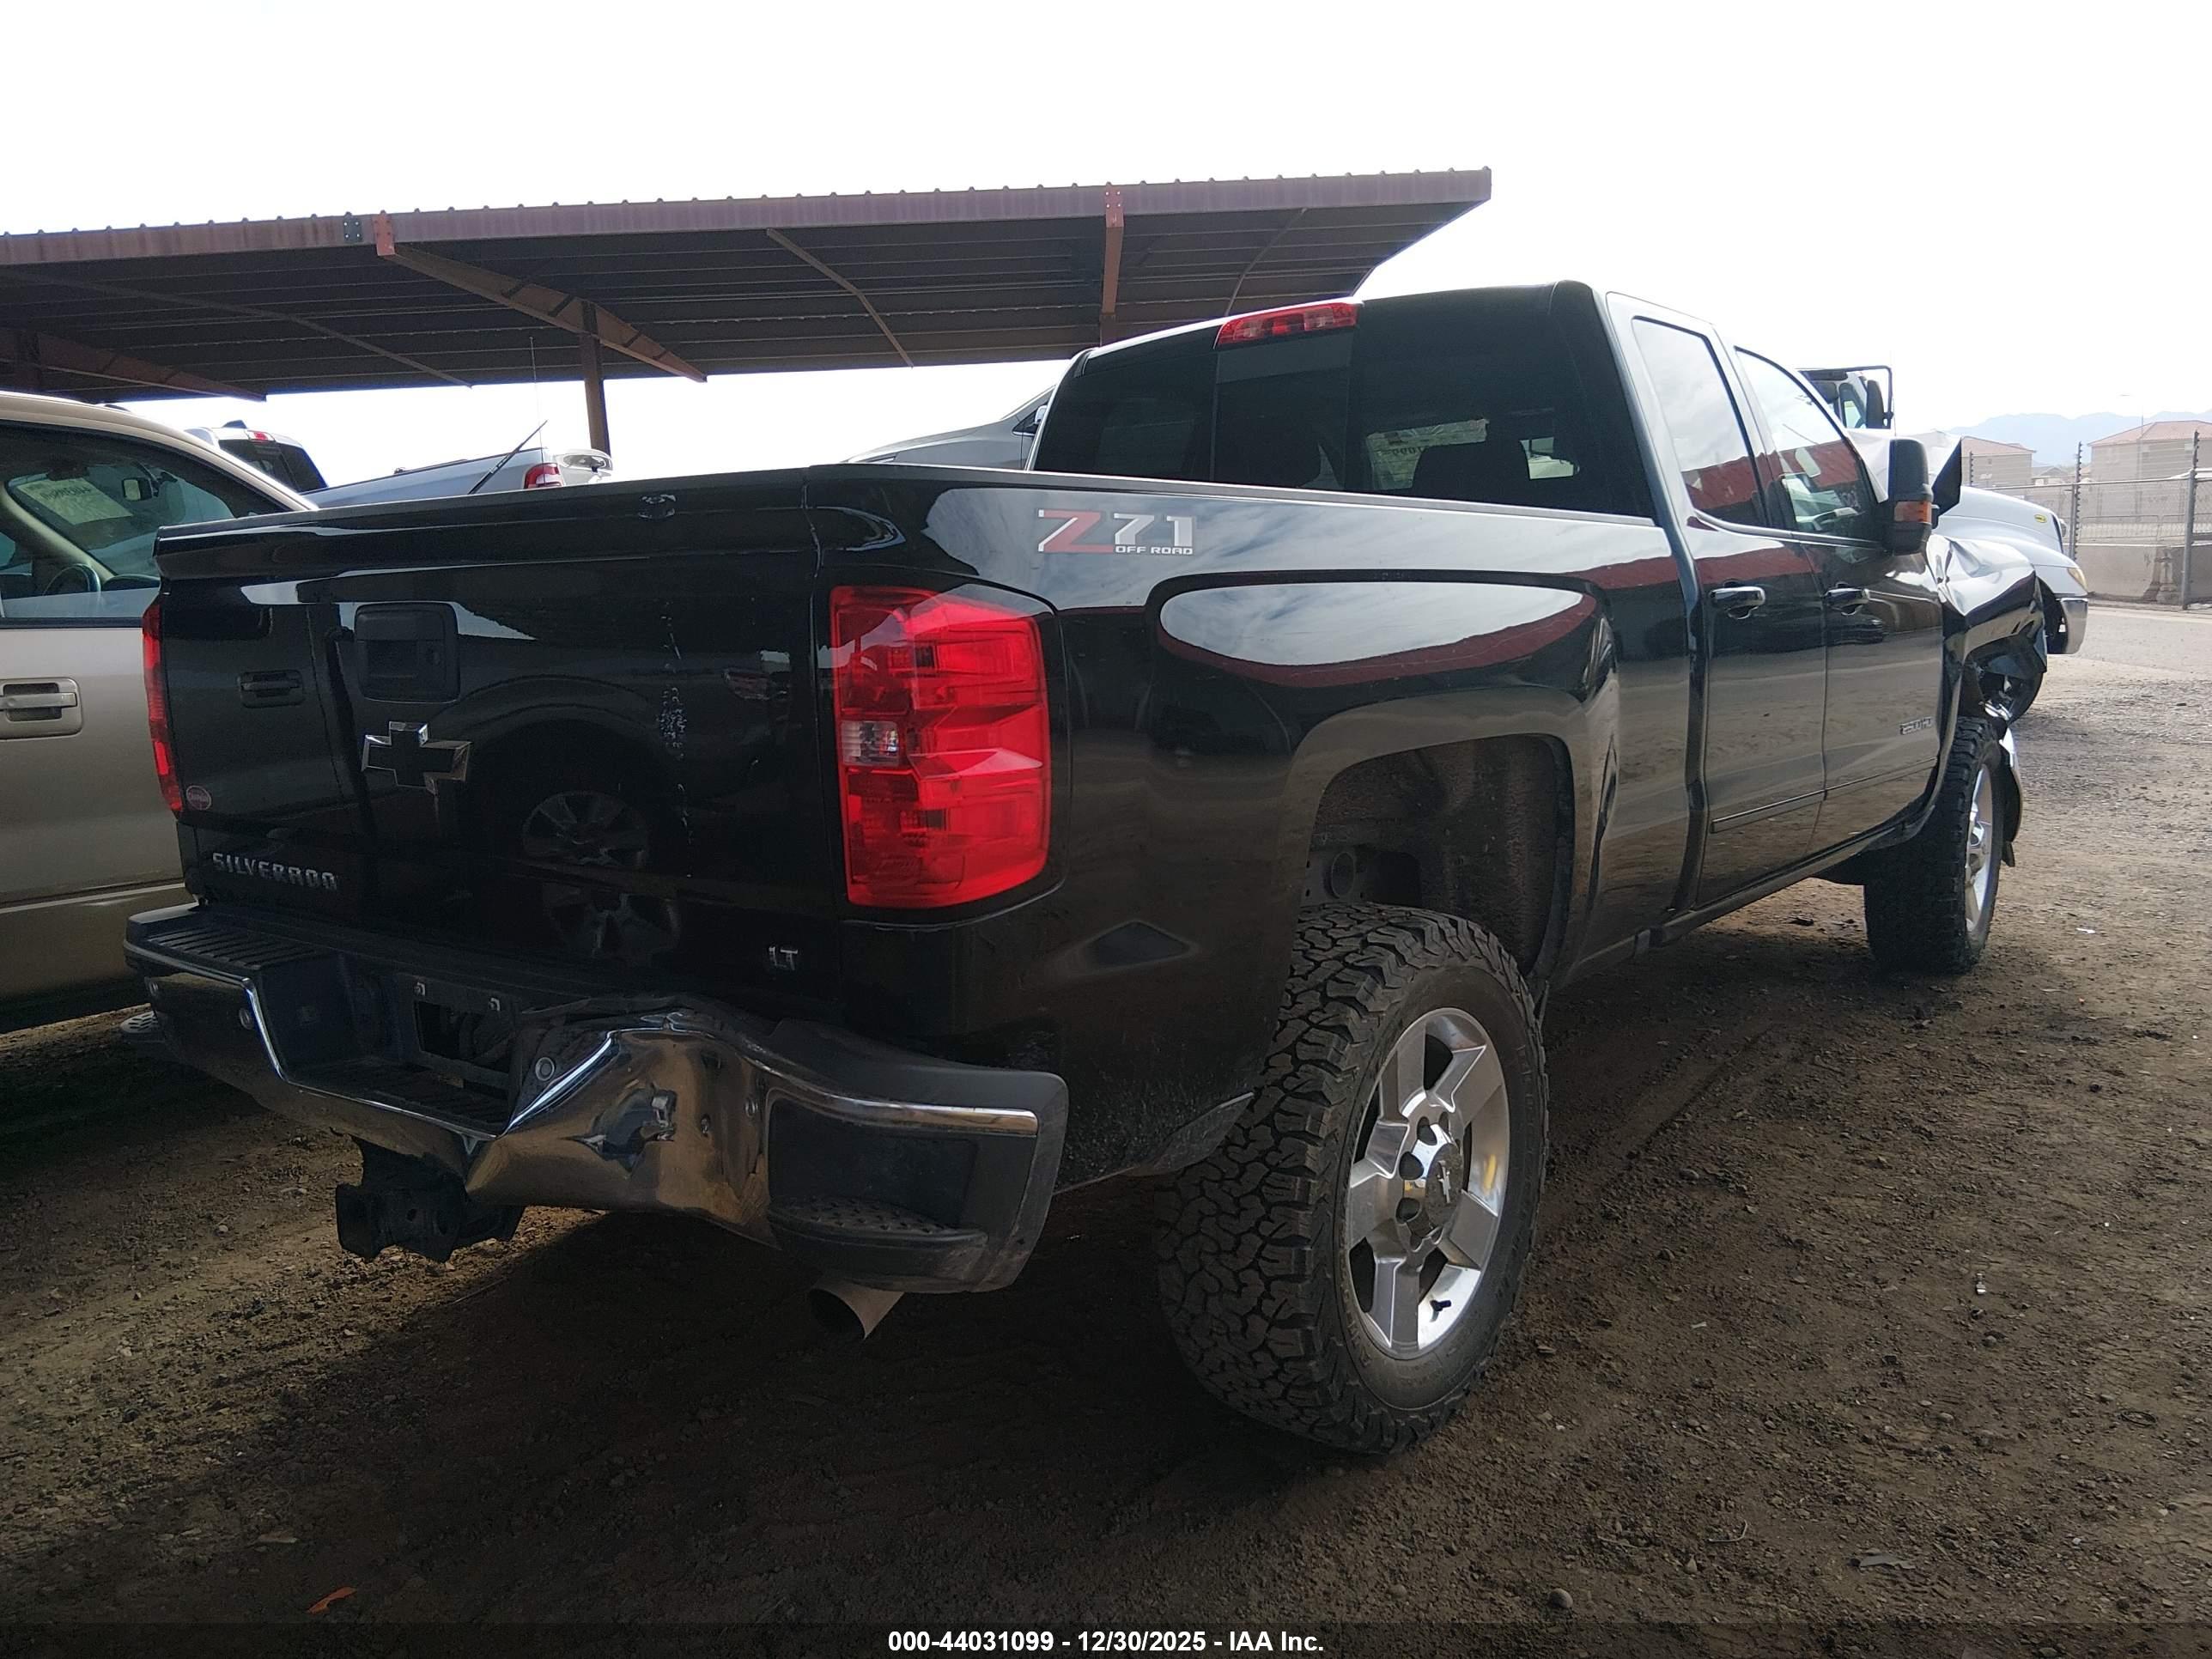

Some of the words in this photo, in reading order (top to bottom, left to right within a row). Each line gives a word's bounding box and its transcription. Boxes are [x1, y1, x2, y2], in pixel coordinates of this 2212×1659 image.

[1038, 509, 1194, 553] Z71
[1115, 545, 1146, 554] OFF
[1151, 546, 1194, 556] ROAD
[212, 853, 338, 890] SILVERADO
[769, 946, 799, 970] LT
